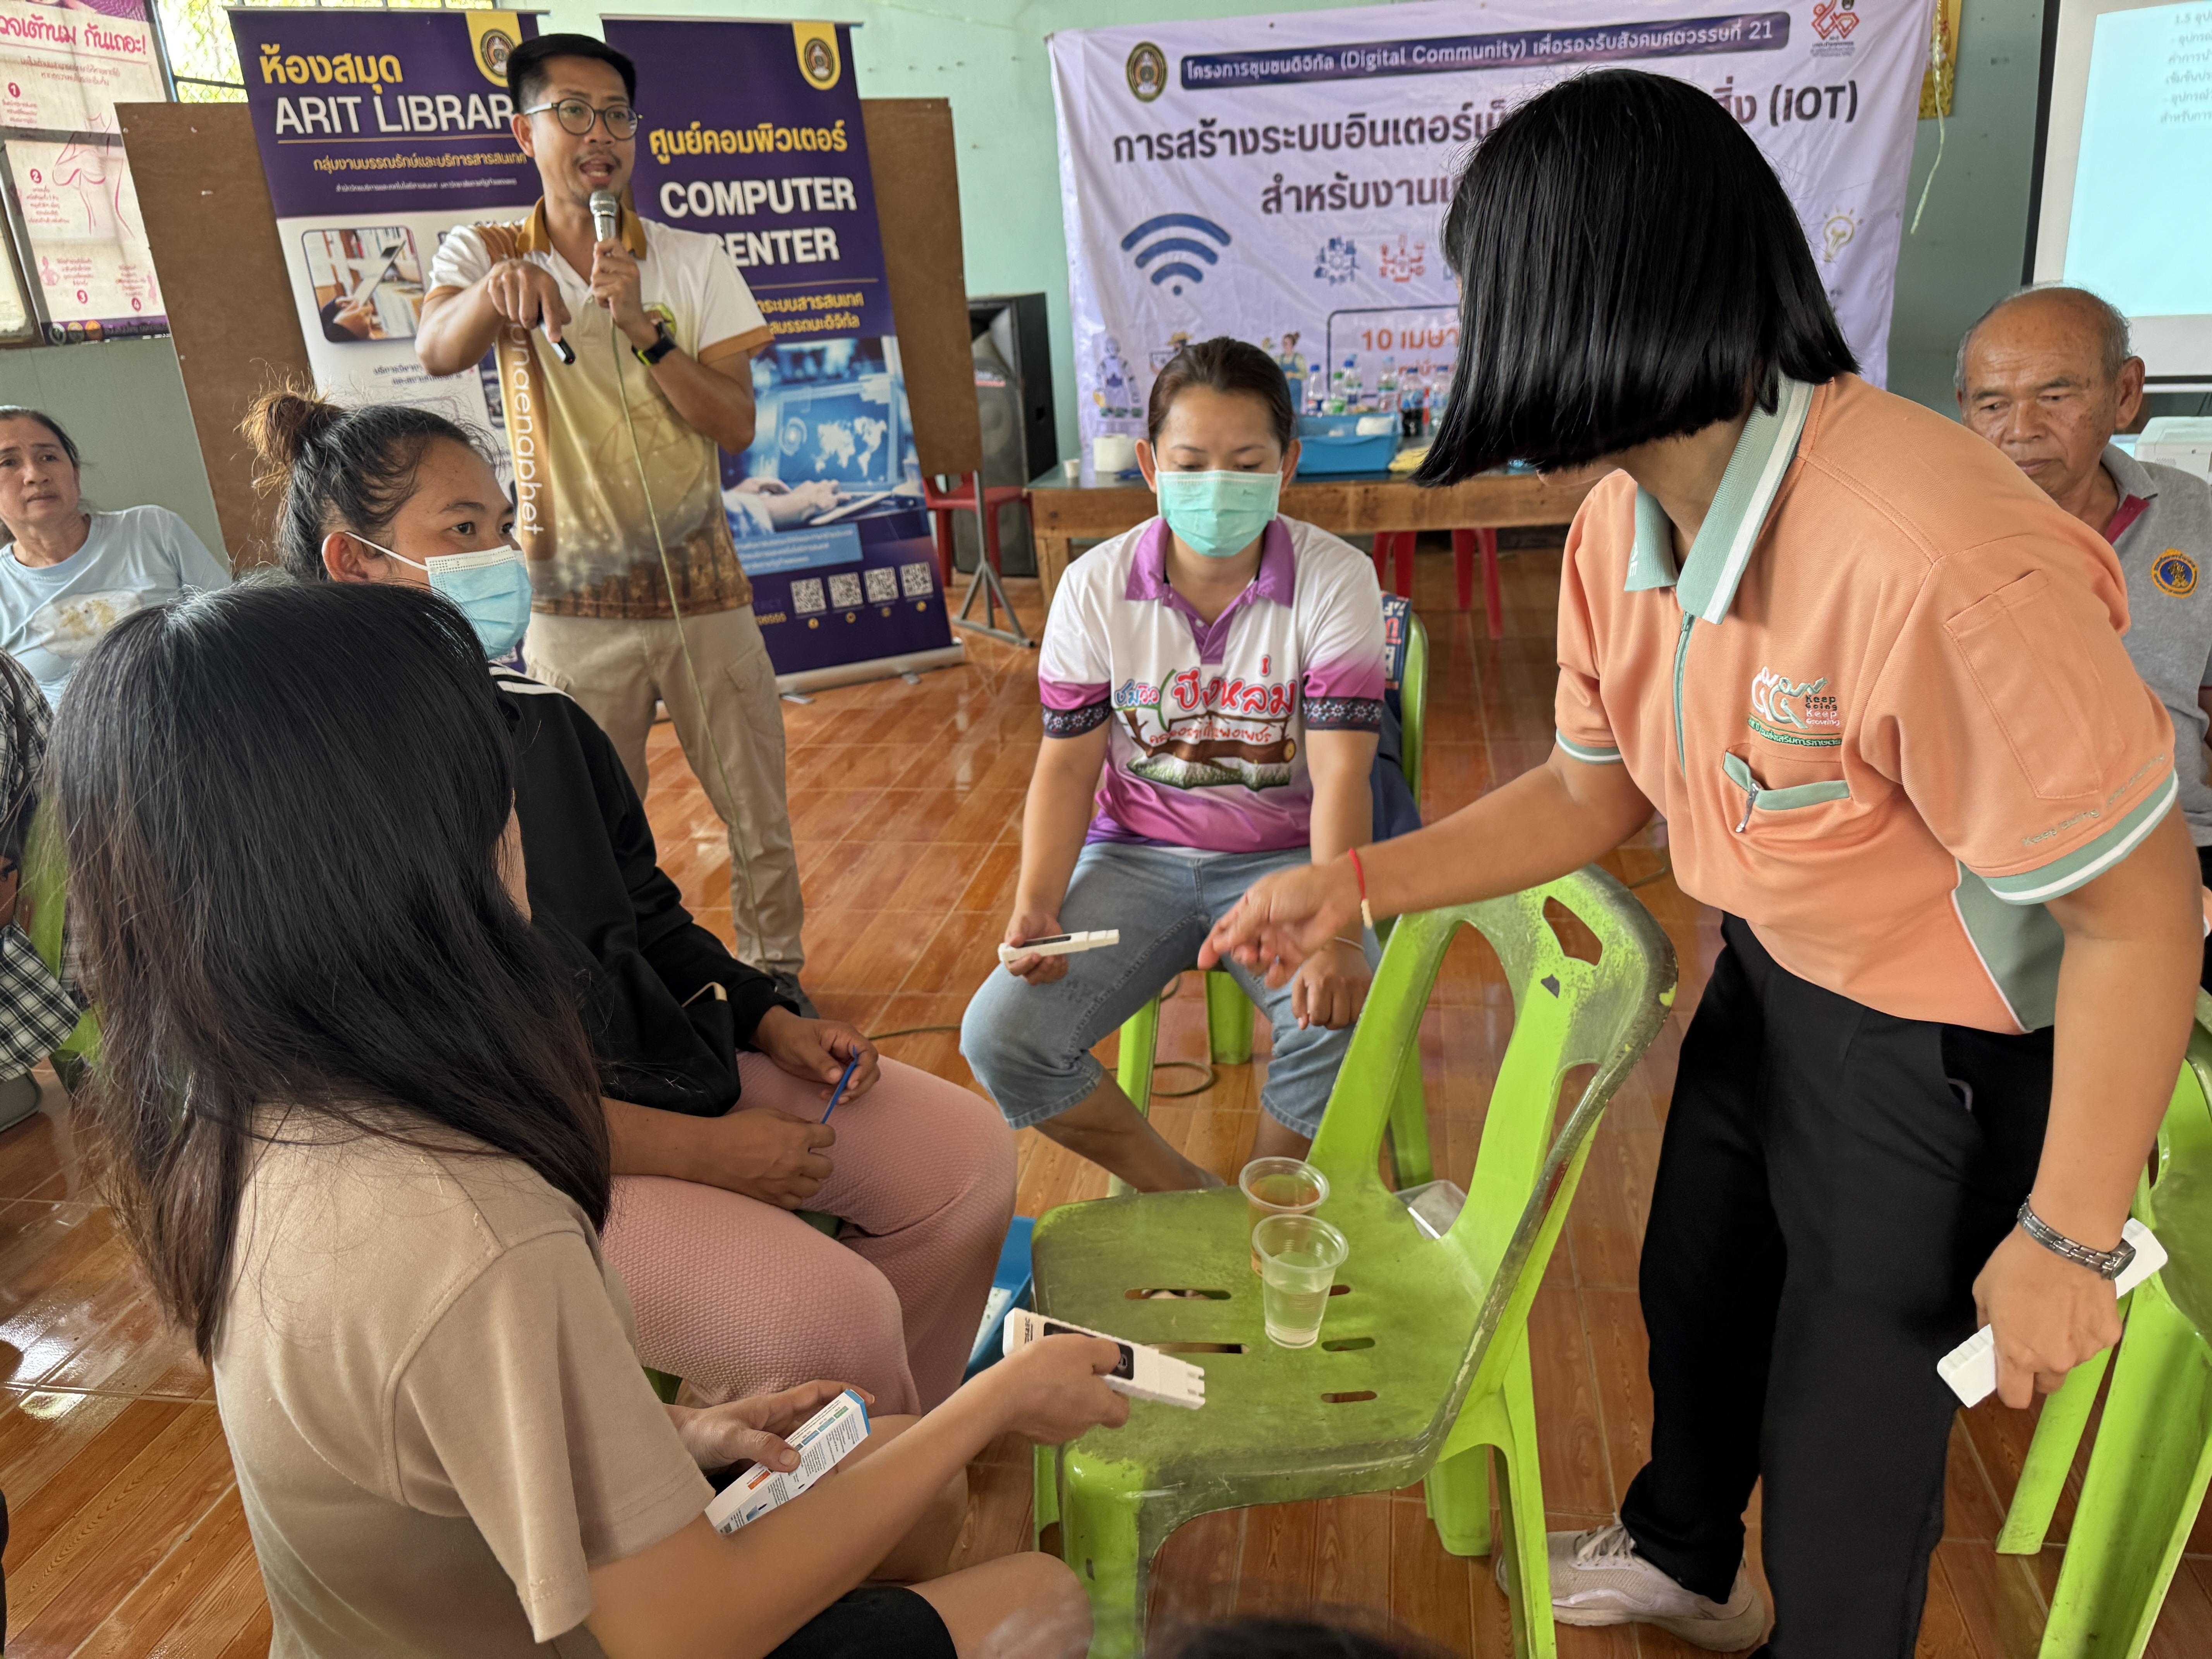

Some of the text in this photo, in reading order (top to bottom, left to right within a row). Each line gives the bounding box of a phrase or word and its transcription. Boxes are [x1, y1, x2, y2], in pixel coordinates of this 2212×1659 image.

[260, 43, 403, 94] ห้องสมุด
[1187, 18, 1772, 81] โครงการชุมชนดิจิทัล (Digital Community) เพื่อรองรับสังคมศตวรรษที่ 21
[276, 93, 514, 134] ARIT LIBRAR
[1770, 80, 1858, 127] (IOT)
[649, 120, 848, 164] ศูนย์คอมพิวเตอร์
[660, 177, 857, 218] COMPUTER
[1361, 329, 1393, 351] 10
[1805, 695, 1836, 705] Keep
[1806, 709, 1837, 720] Keep
